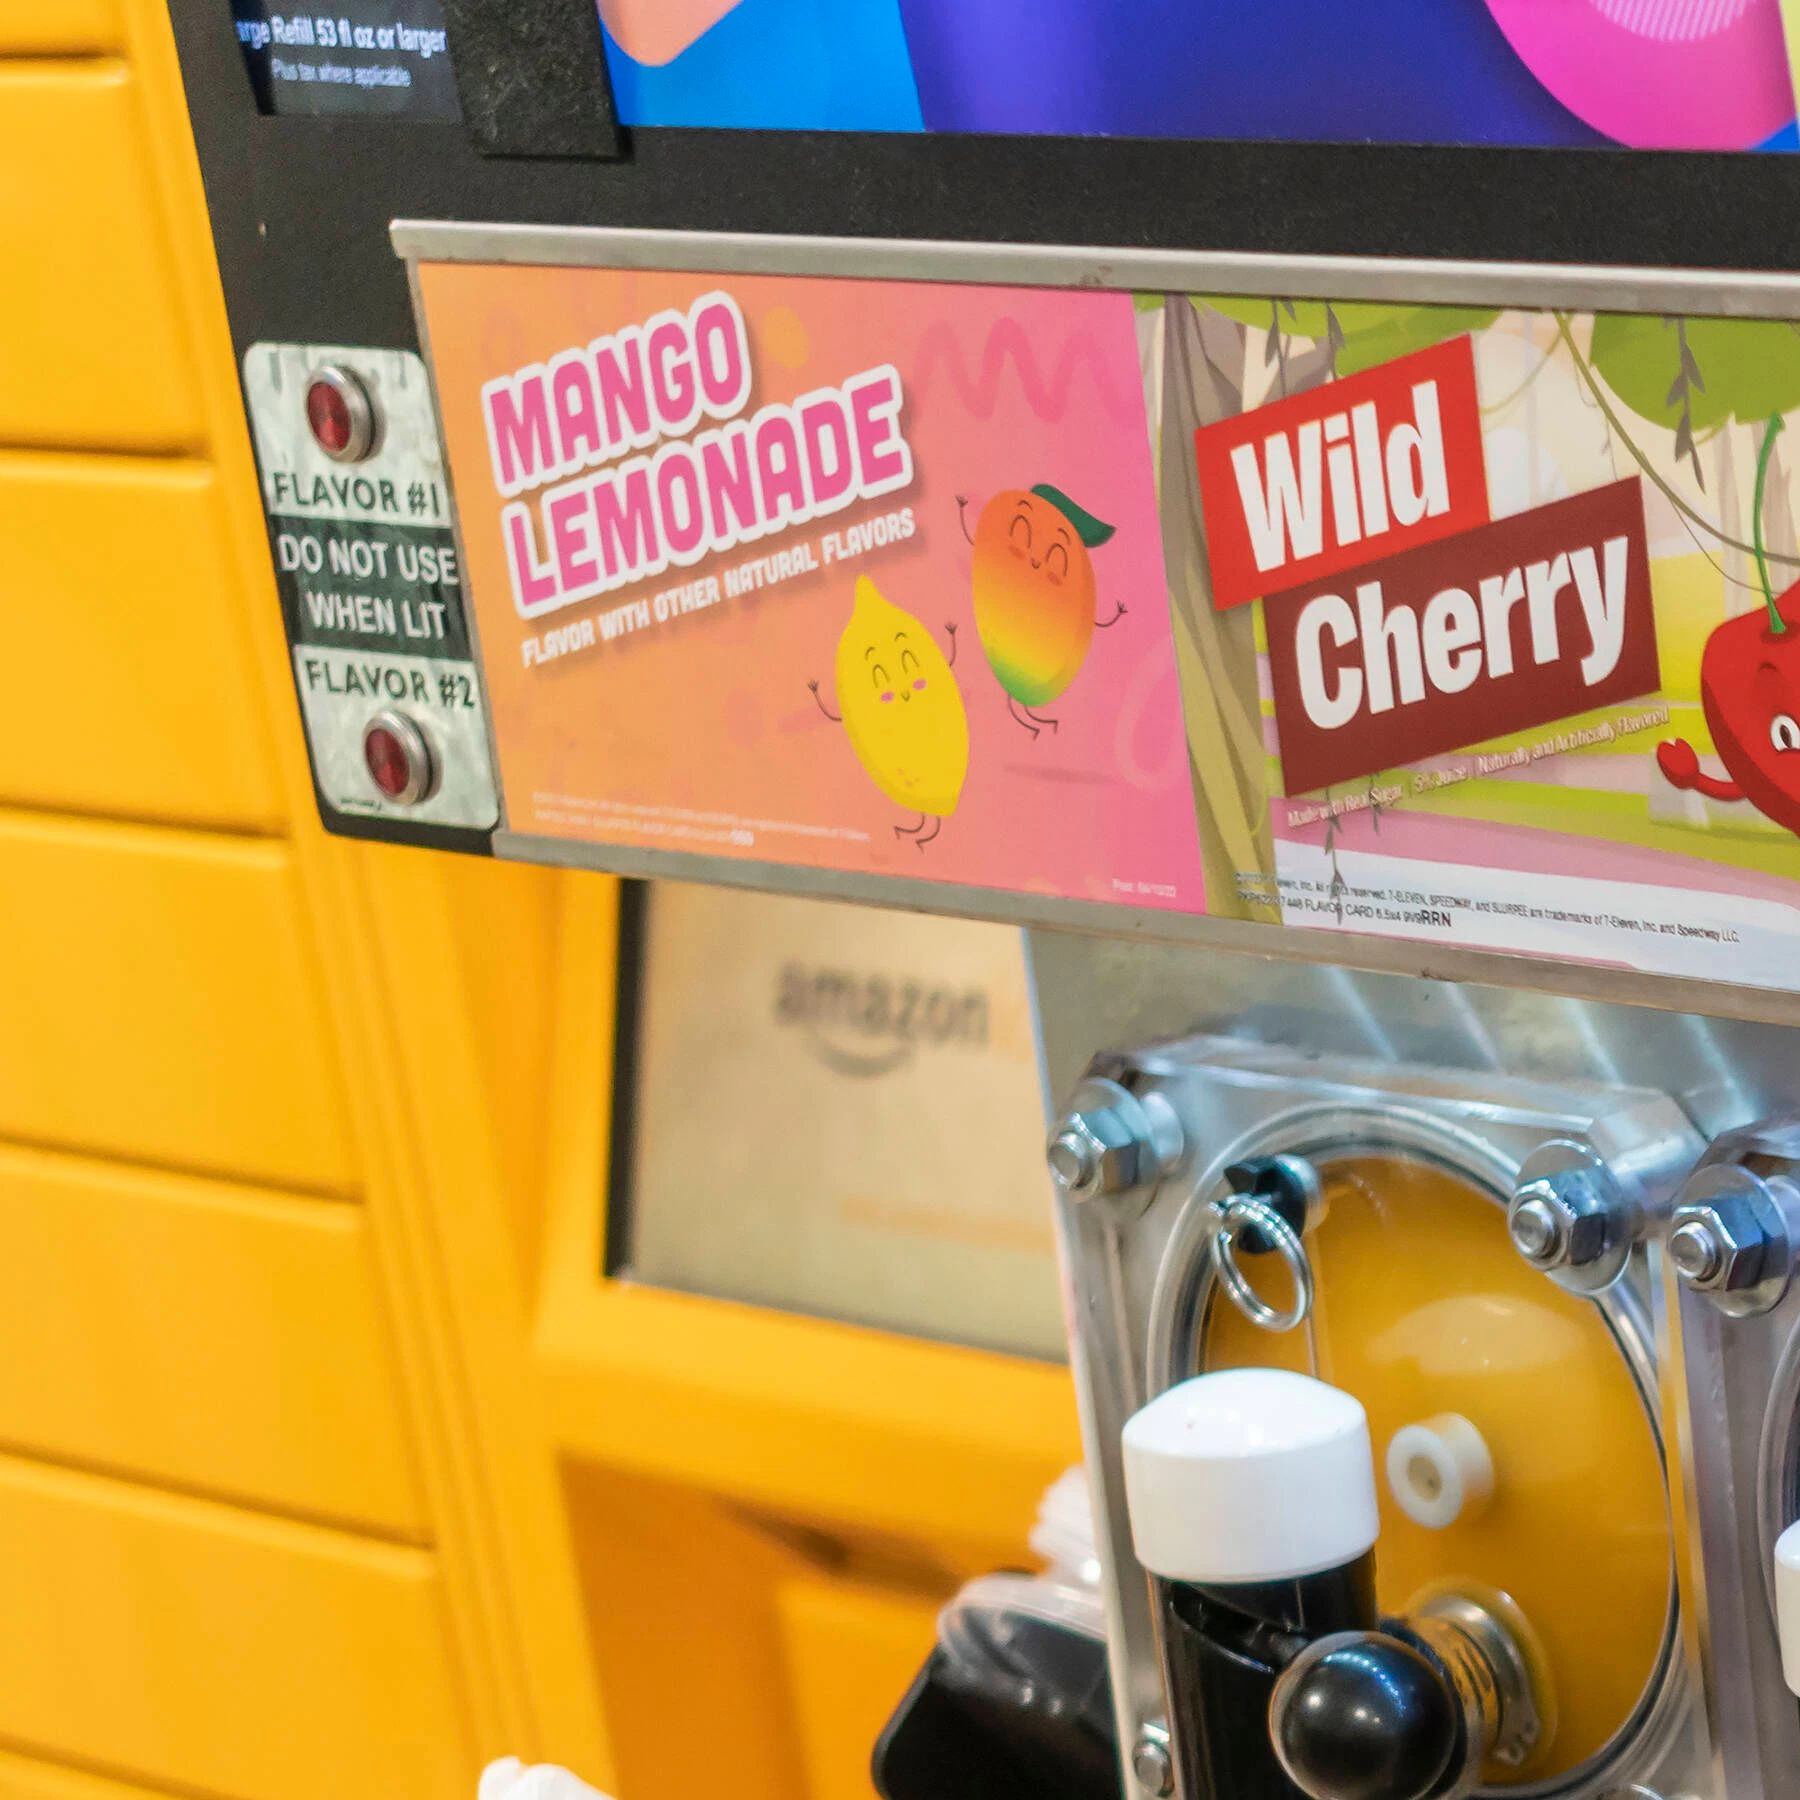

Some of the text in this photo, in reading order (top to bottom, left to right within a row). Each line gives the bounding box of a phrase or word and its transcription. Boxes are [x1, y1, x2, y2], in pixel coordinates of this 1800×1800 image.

[271, 16, 315, 46] Refill
[315, 17, 337, 47] 53
[376, 28, 395, 49] or
[396, 22, 446, 59] larger
[484, 293, 750, 494] MANGO
[272, 471, 440, 518] FLAVOR #1
[503, 366, 913, 617] LEMONADE
[1230, 380, 1451, 574] Wild
[278, 533, 459, 586] DO NOT USE
[521, 508, 916, 668] FLAVOR WITH OTHER NATURAL FLAVORS
[305, 591, 447, 641] WHEN LIT
[1293, 535, 1629, 730] Cherry
[304, 658, 476, 709] FLAVOR #2
[1346, 904, 1374, 918] CARD
